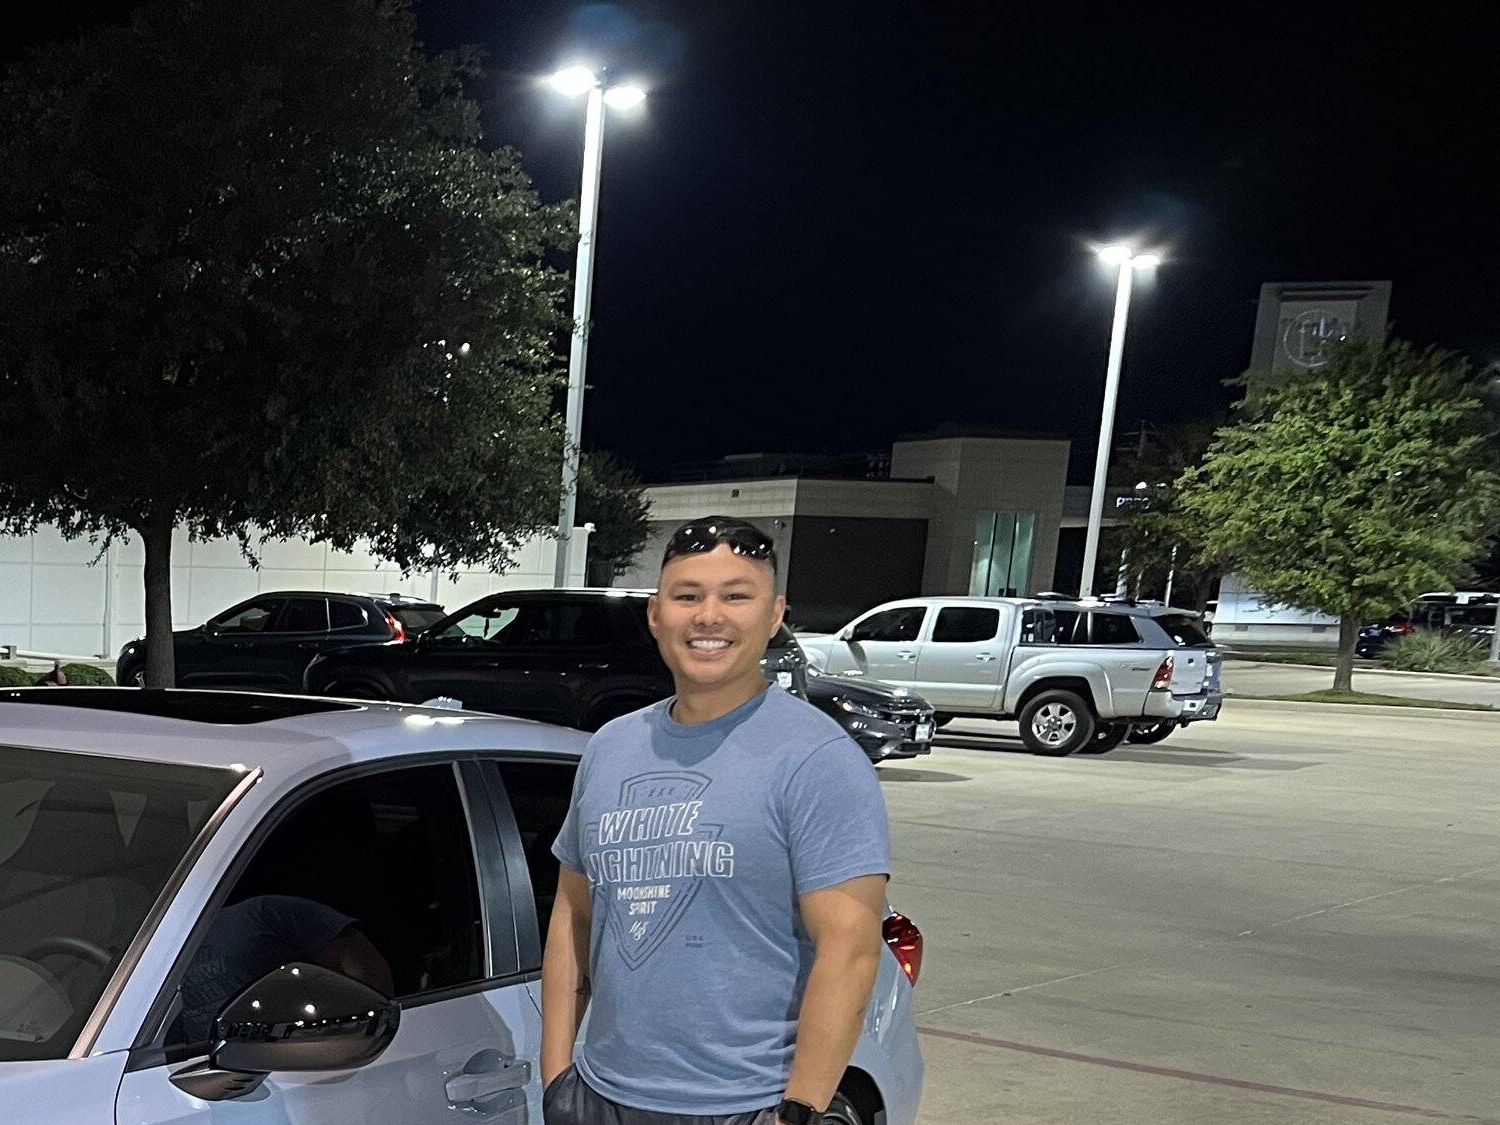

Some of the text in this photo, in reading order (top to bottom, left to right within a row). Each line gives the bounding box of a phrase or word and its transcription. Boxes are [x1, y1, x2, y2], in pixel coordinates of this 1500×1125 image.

[599, 801, 703, 846] WHITE
[617, 884, 672, 901] MOONSHINE
[628, 900, 658, 916] SPIRIT
